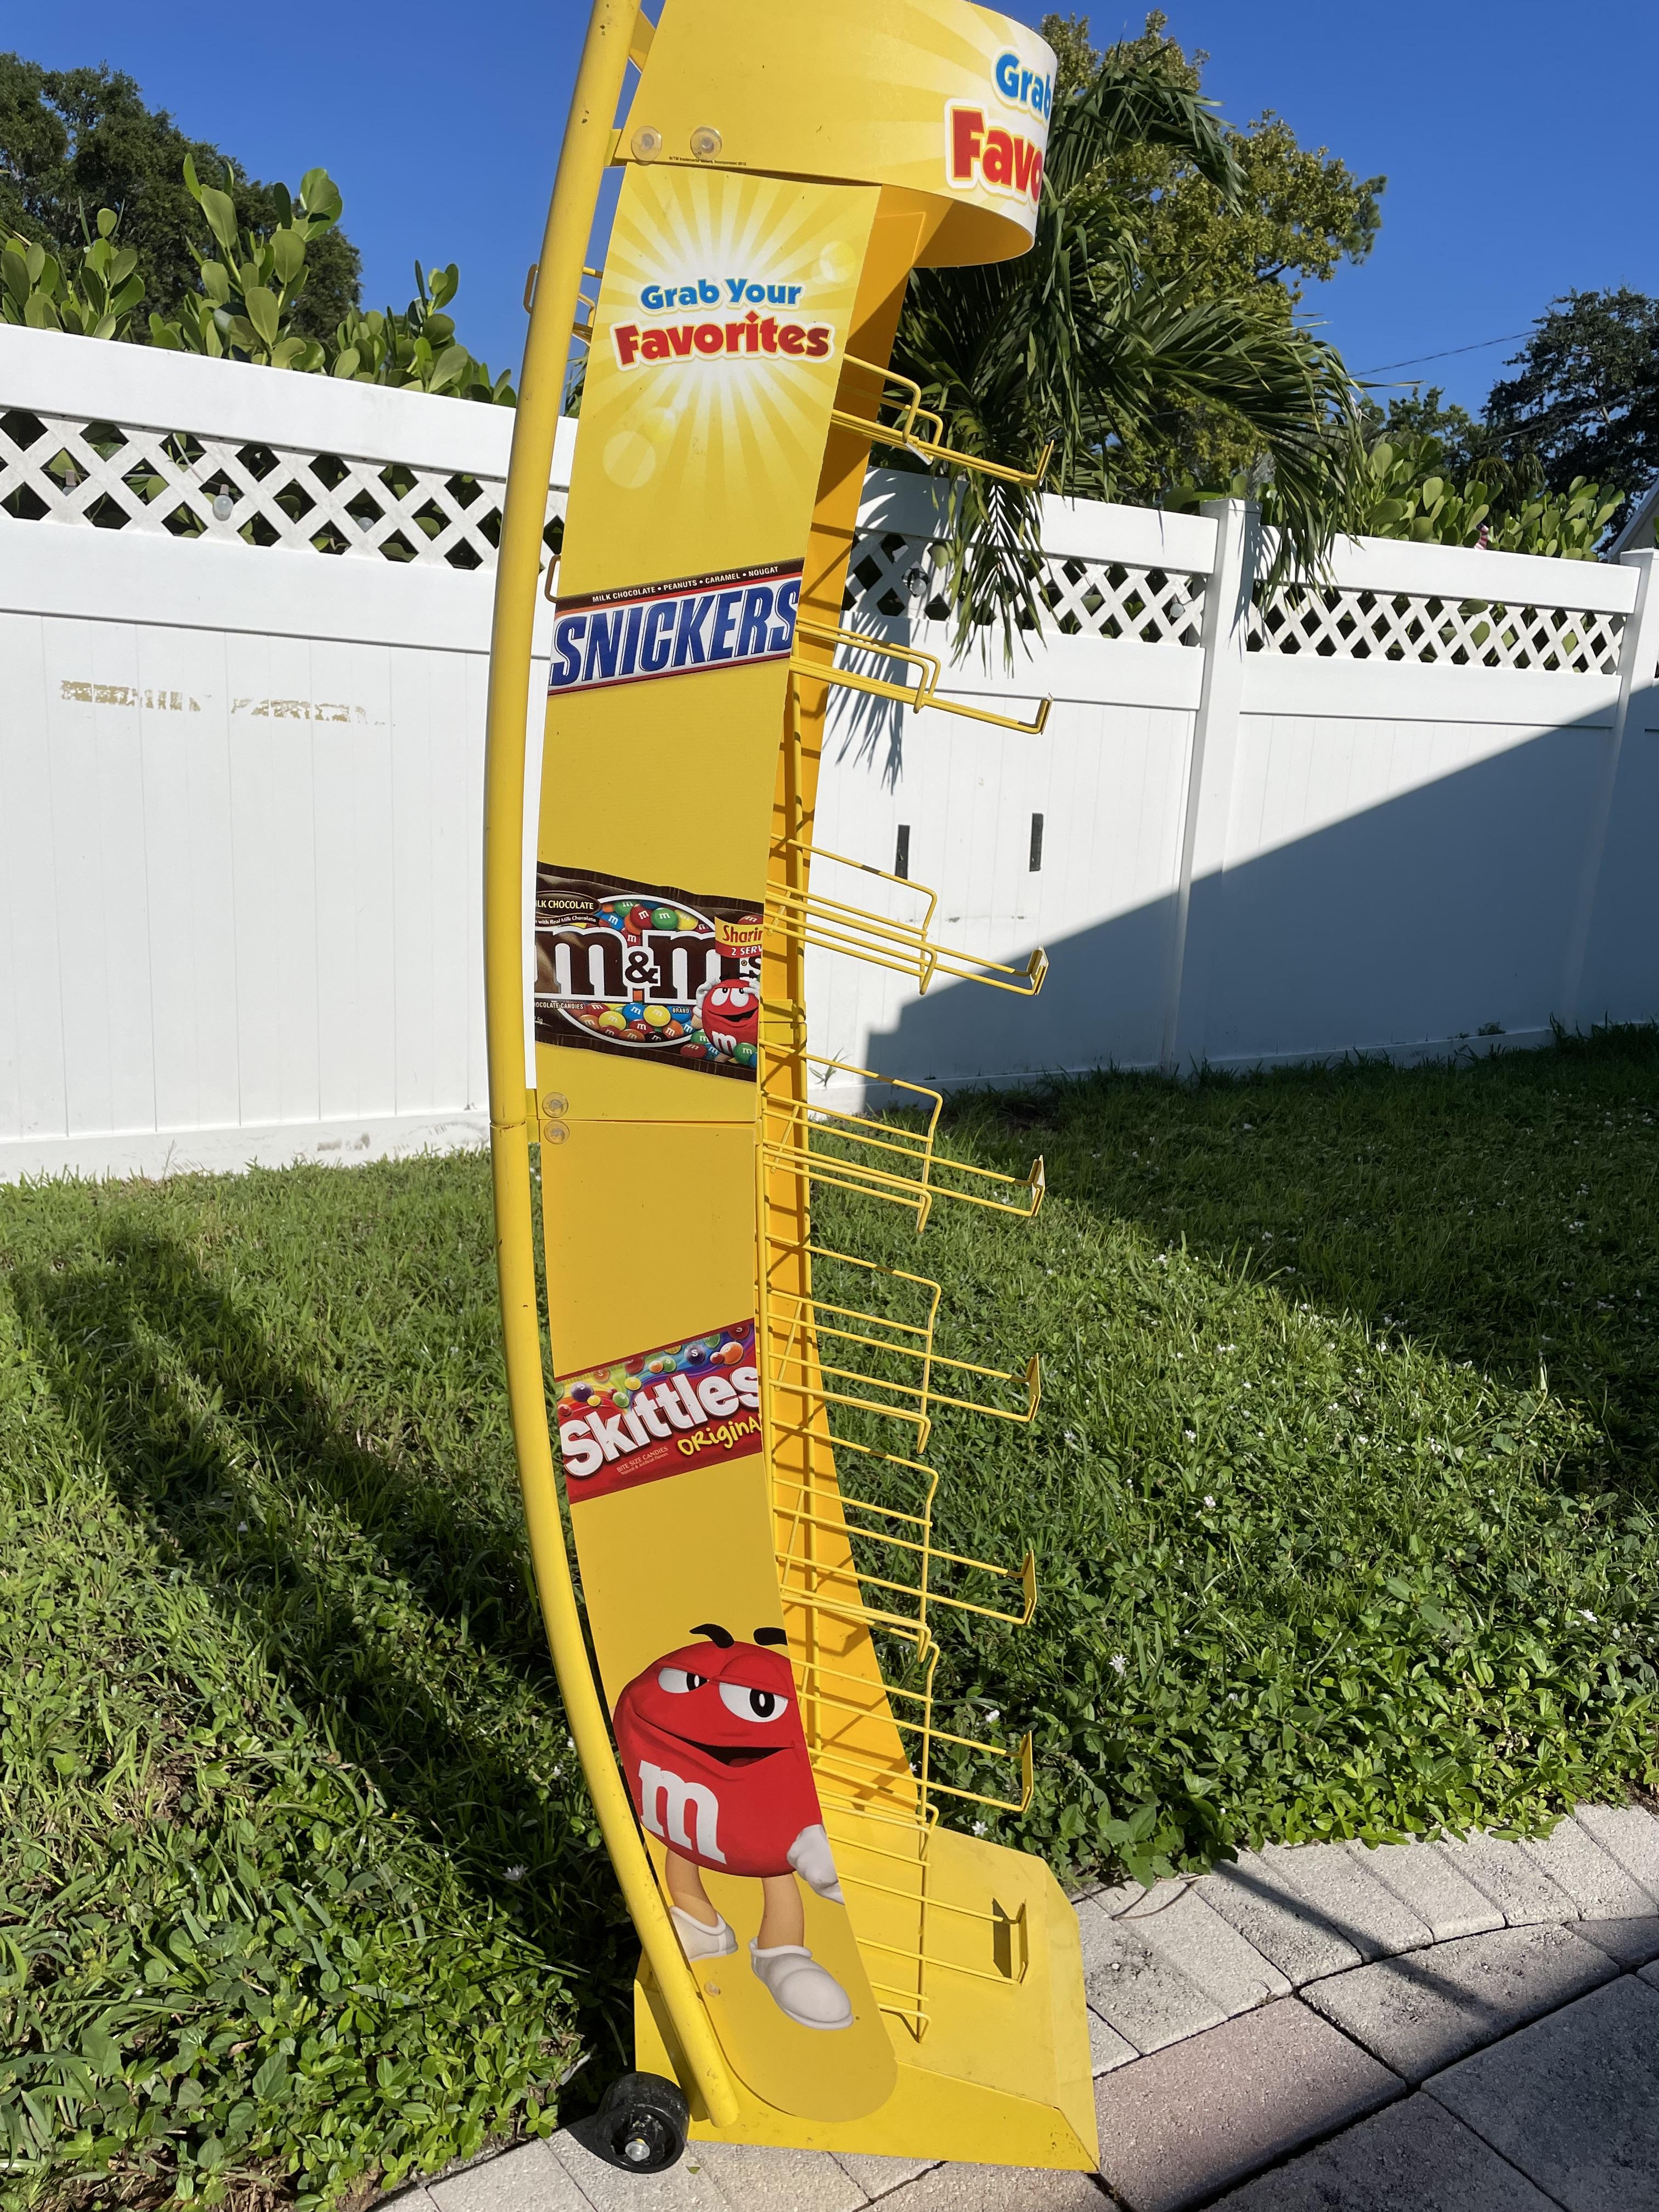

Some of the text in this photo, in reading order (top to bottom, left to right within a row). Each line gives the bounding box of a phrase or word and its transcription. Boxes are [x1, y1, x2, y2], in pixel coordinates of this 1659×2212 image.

[996, 52, 1051, 120] Grab
[952, 109, 1043, 202] Favo
[641, 278, 803, 310] Grab Your
[614, 311, 830, 365] Favorites
[592, 566, 779, 603] MILK CHOCOLATE PEANUTS CARAMEL NOUGAT
[549, 580, 802, 686] SNICKERS
[548, 900, 594, 910] CHOCOLATE
[731, 945, 763, 956] 2 SERV
[560, 1367, 759, 1476] Skittles
[617, 1446, 668, 1472] BITE SIZE CANDIES
[638, 1760, 727, 1864] m
